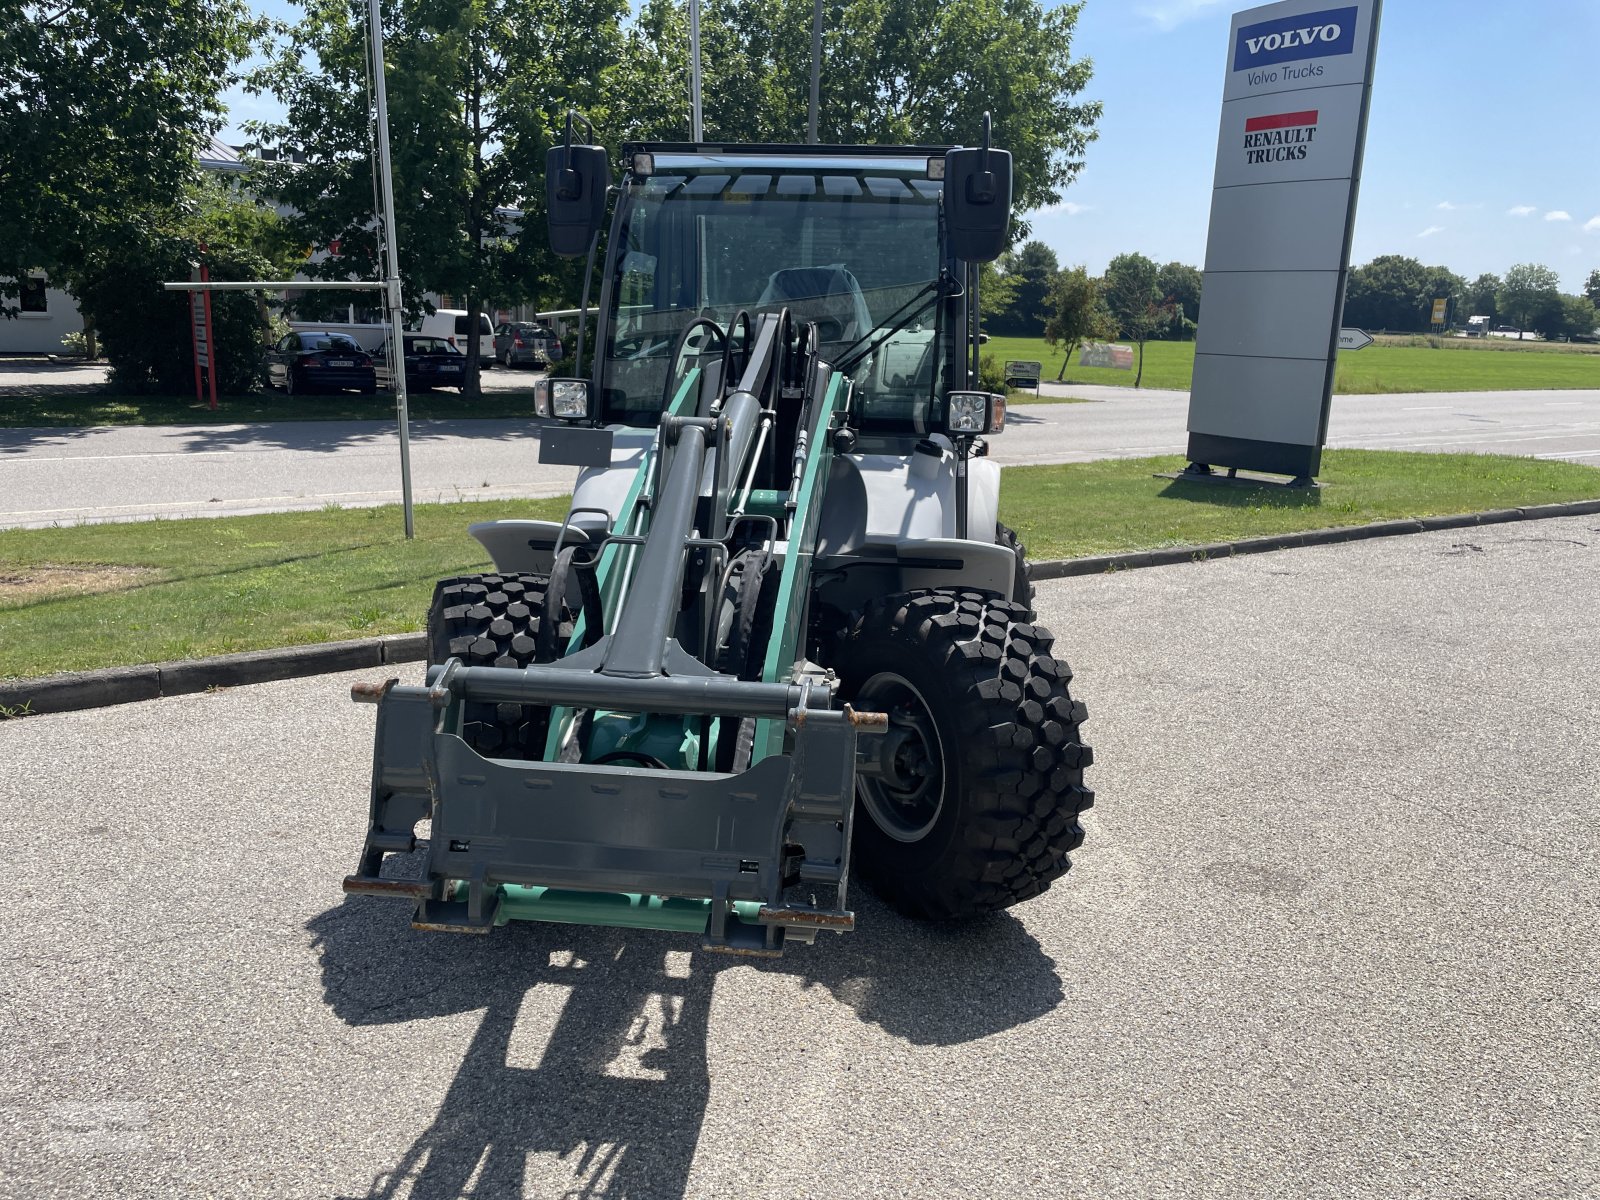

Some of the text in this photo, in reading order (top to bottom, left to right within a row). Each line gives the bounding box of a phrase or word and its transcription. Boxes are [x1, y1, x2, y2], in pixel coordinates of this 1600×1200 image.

[1245, 23, 1341, 54] VOLVO
[1248, 63, 1324, 86] Volvo Trucks
[1243, 127, 1316, 148] RENAULT
[1246, 144, 1307, 165] TRUCKS
